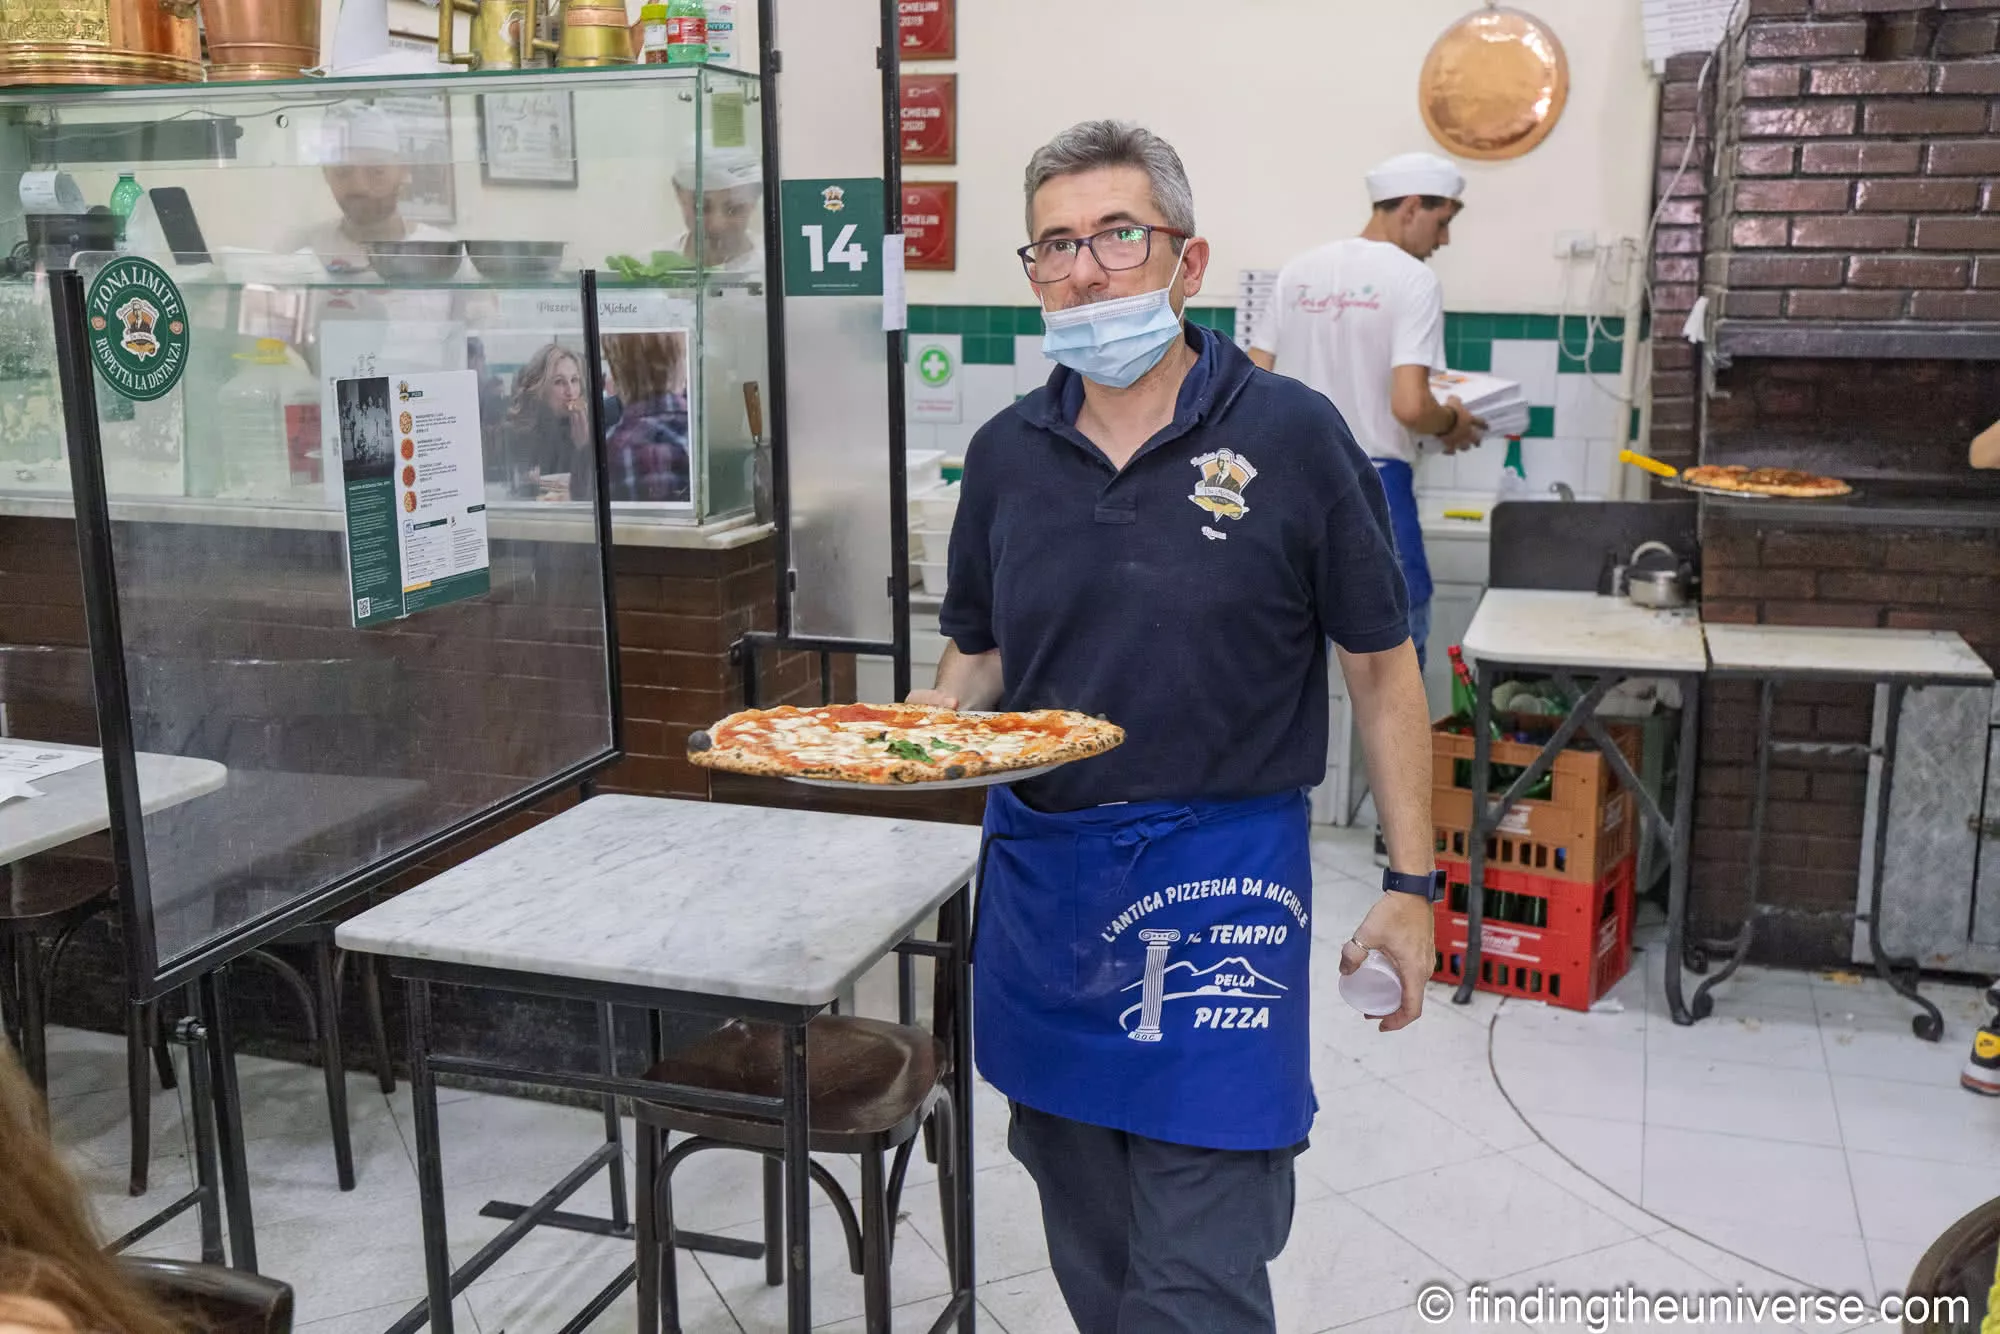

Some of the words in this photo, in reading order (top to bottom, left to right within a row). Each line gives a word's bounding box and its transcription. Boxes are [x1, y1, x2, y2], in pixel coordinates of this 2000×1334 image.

[898, 2, 939, 12] CHELIN
[900, 107, 940, 118] CHELIN
[901, 214, 939, 224] CHELIN
[802, 224, 868, 272] 14
[94, 269, 131, 315] ZONA
[132, 266, 180, 318] LIMITE
[600, 302, 638, 315] Michele
[95, 337, 132, 388] RISPETTA
[135, 375, 148, 390] LA
[148, 342, 181, 389] DISTANZA
[1101, 891, 1164, 943] L'ANTICA
[1166, 877, 1237, 905] PIZZERIA
[1242, 877, 1263, 897] DA
[1264, 882, 1310, 928] MICHELE
[1209, 924, 1288, 945] TEMPIO
[1214, 974, 1255, 987] DELLA
[1194, 1007, 1270, 1029] PIZZA
